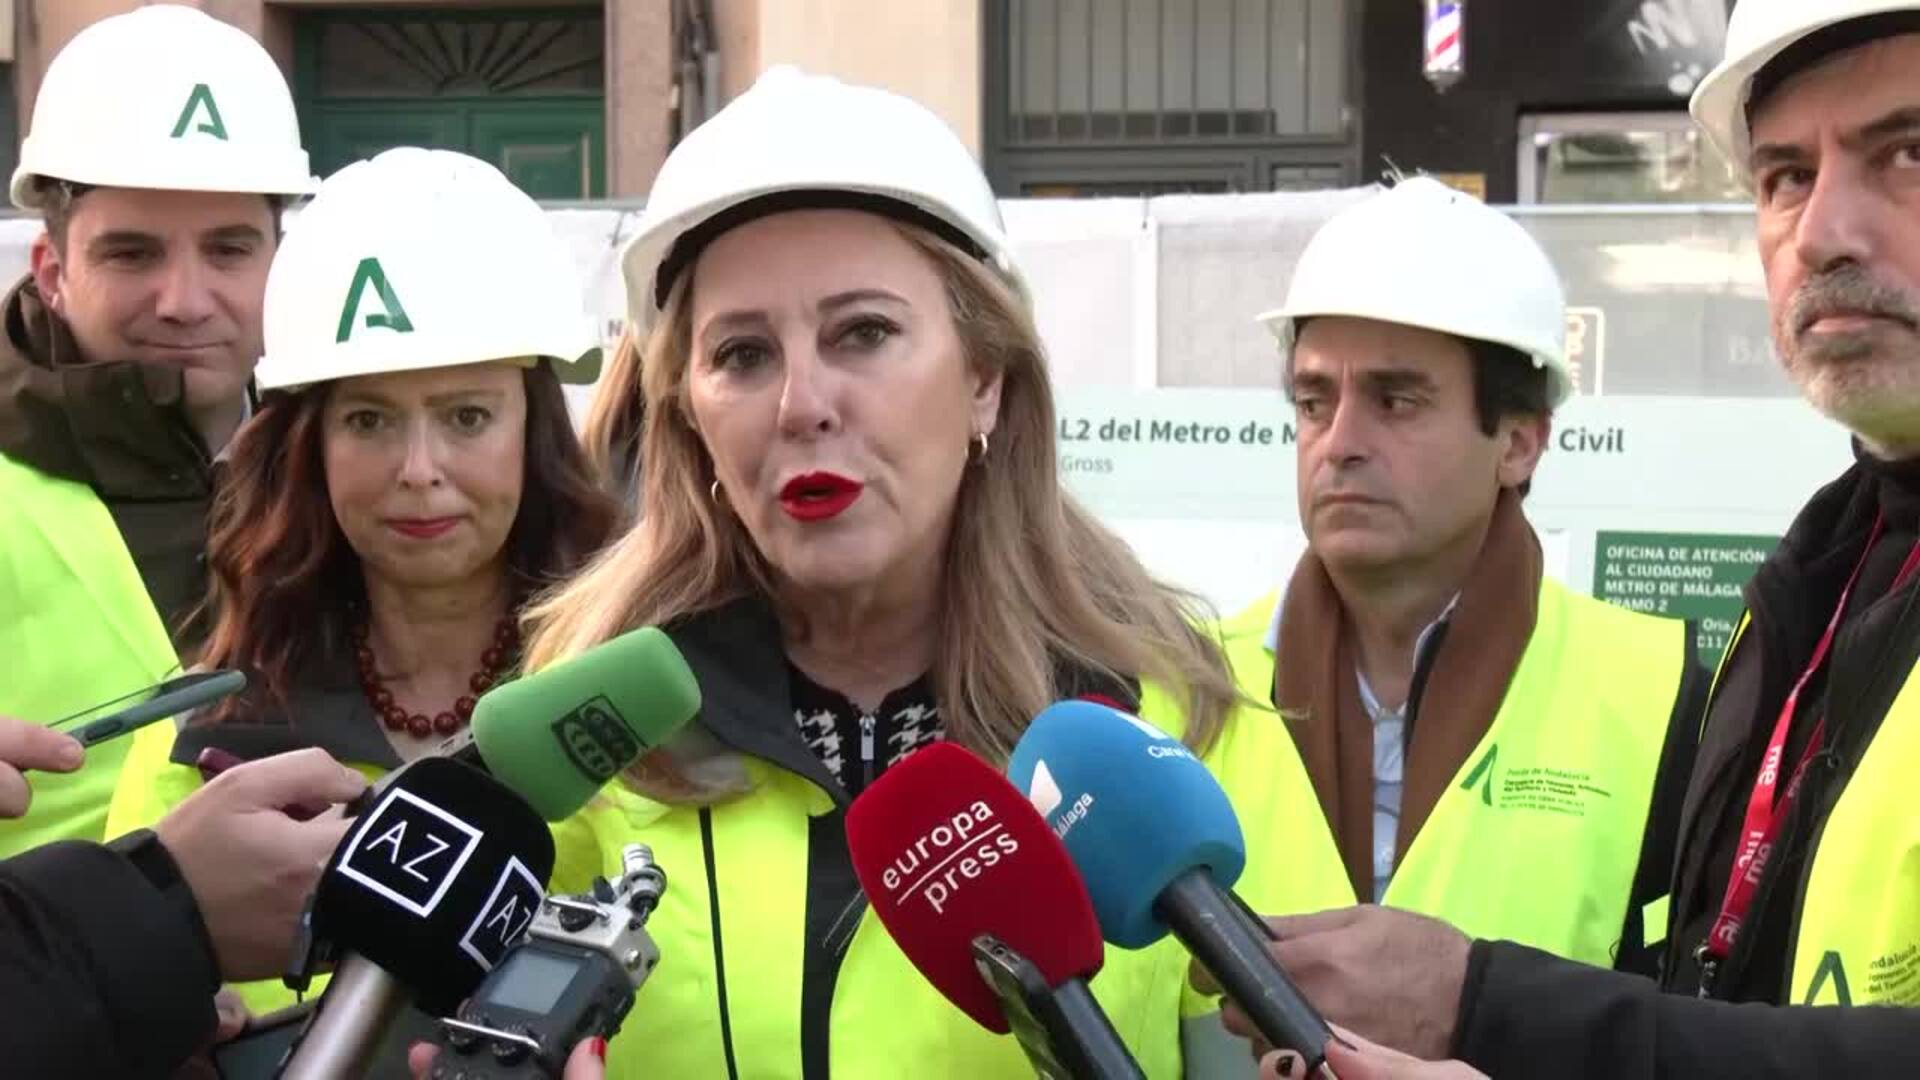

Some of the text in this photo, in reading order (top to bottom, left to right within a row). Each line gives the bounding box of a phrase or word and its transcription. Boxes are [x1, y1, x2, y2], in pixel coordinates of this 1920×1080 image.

[1060, 419, 1091, 441] L2
[1099, 419, 1141, 442] del
[1150, 420, 1231, 444] Metro
[1239, 421, 1273, 444] de
[1559, 427, 1625, 453] Civil
[1061, 455, 1114, 473] Gross
[1607, 546, 1766, 563] OFICINA DE ATENCIÓN
[1605, 563, 1713, 579] AL CIUDADANO
[1605, 580, 1656, 594] METRO
[1660, 581, 1680, 596] DE
[1657, 599, 1669, 613] 2
[366, 820, 451, 882] AZ
[882, 800, 994, 890] europa
[924, 831, 1019, 914] press
